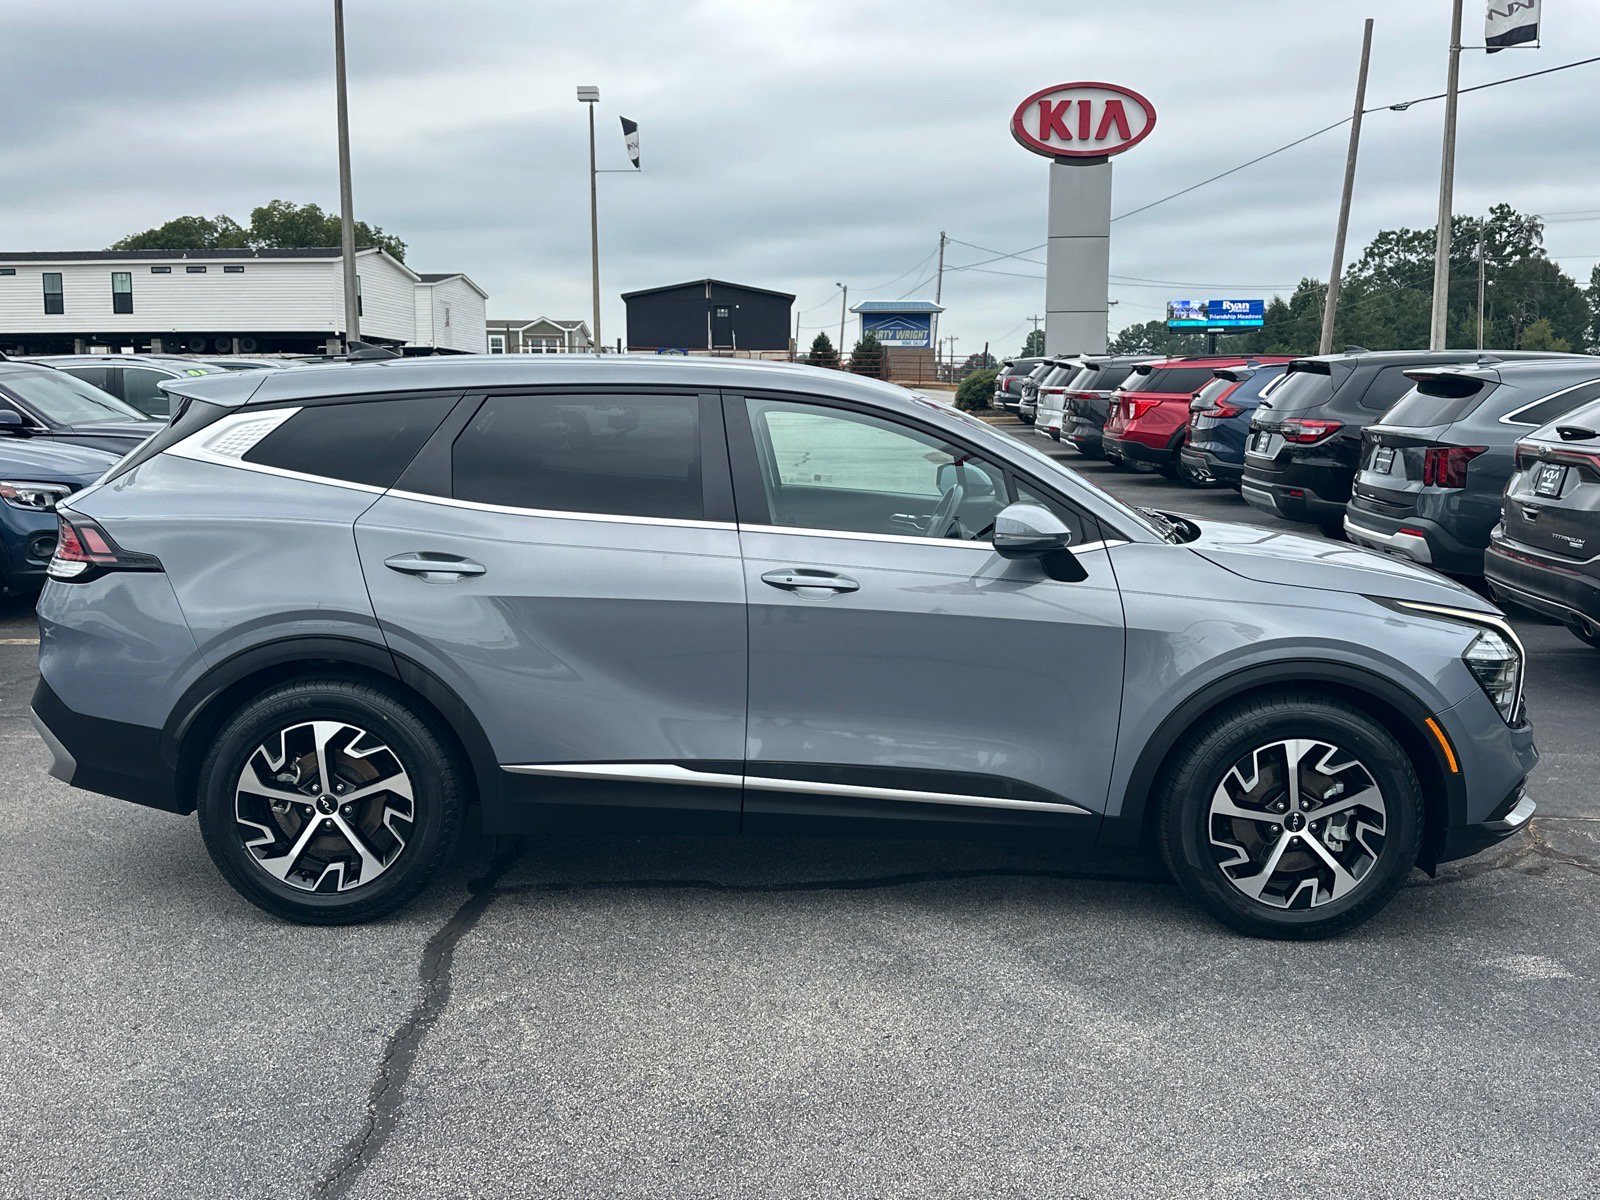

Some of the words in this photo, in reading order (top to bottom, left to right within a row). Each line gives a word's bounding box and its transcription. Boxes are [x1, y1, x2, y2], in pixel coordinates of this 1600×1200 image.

[1038, 100, 1132, 140] KIA
[1222, 301, 1249, 312] Ryan
[896, 330, 929, 340] WRIGHT
